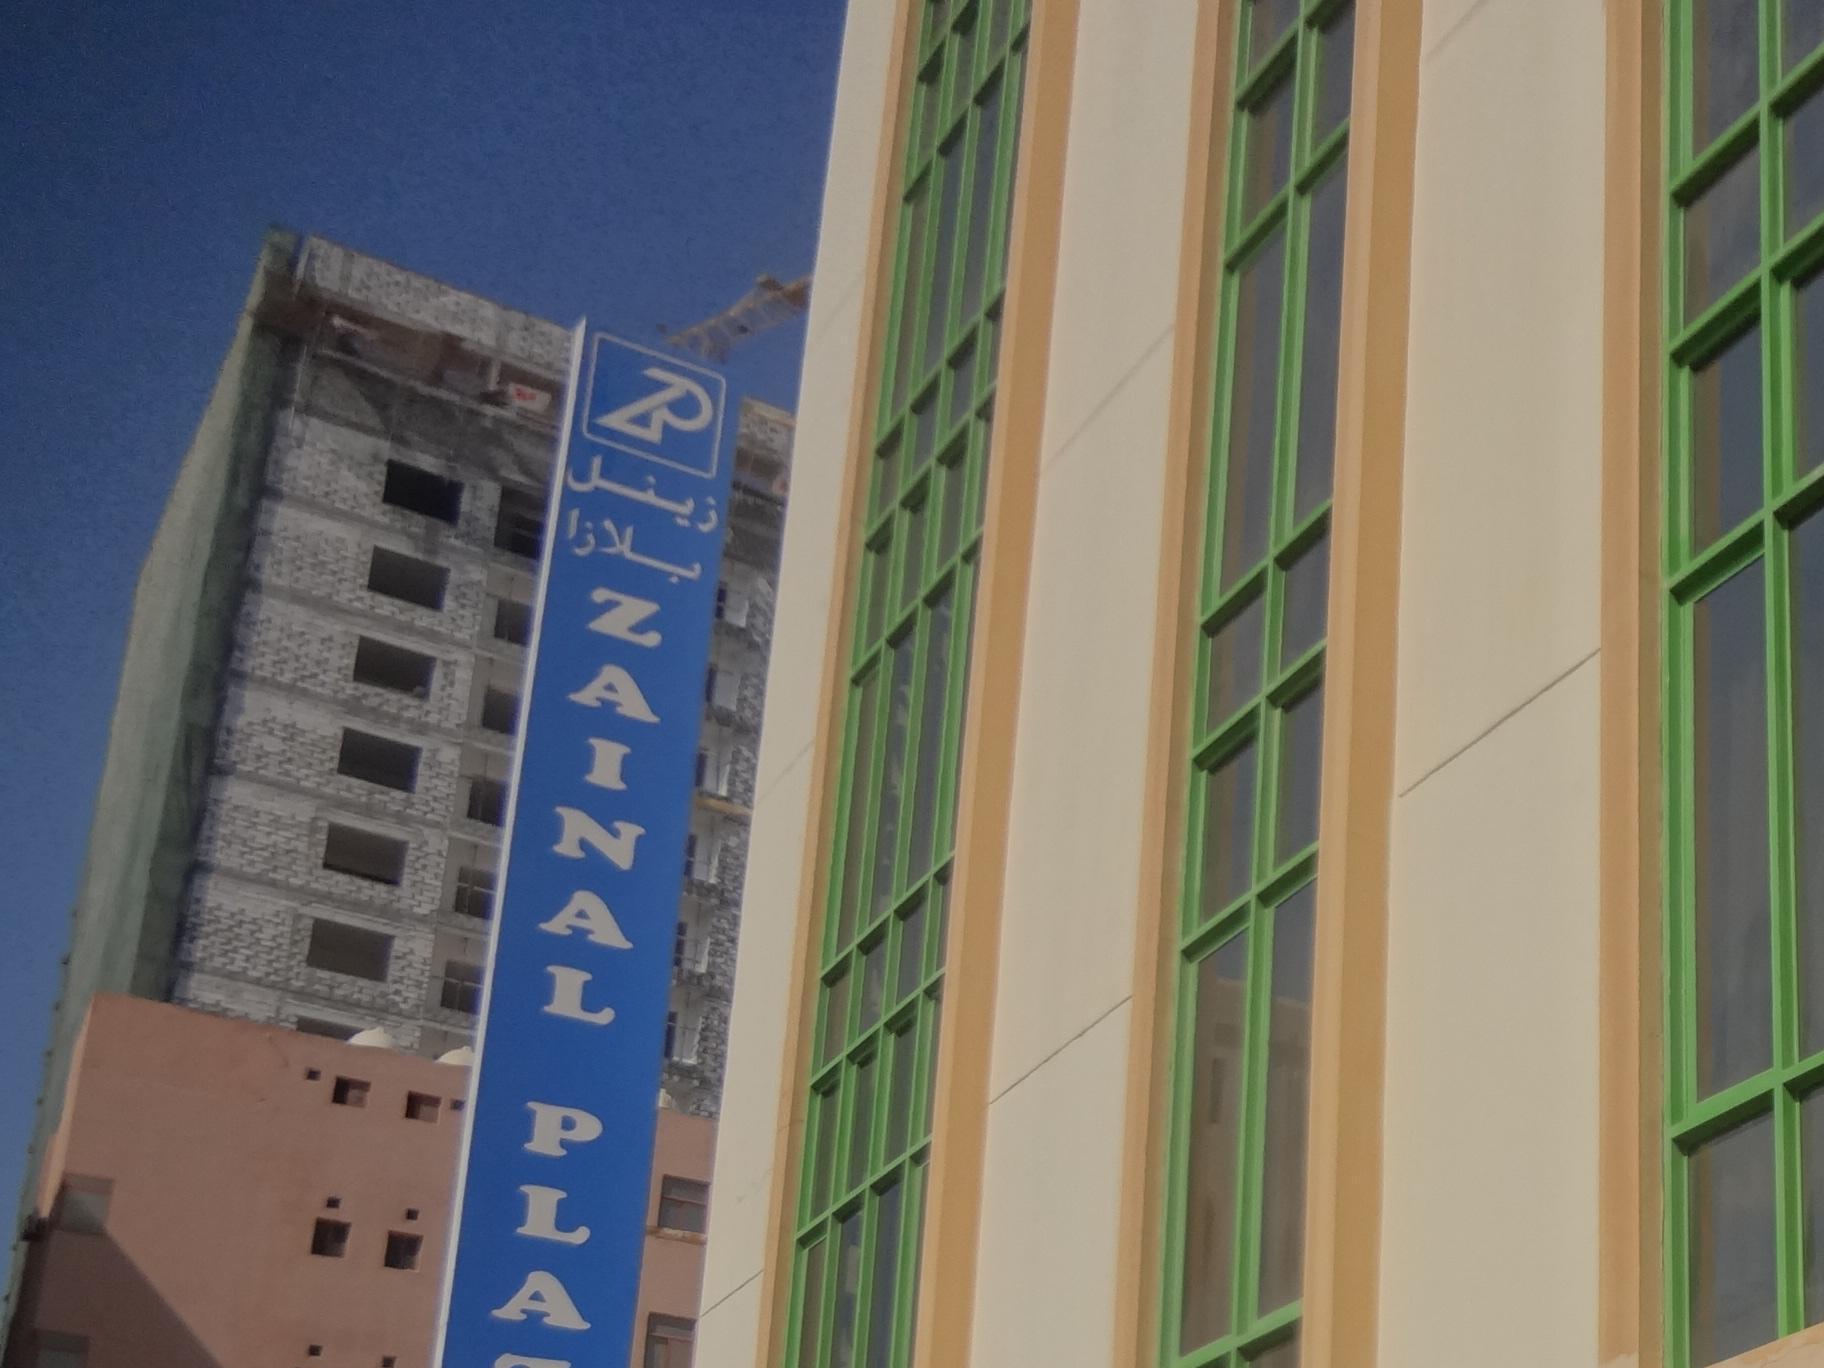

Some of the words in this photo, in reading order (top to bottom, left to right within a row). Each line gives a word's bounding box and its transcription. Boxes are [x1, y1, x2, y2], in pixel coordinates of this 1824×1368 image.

[566, 455, 718, 532] زينل
[568, 508, 702, 584] بلازا
[538, 587, 662, 1025] ZAINAL
